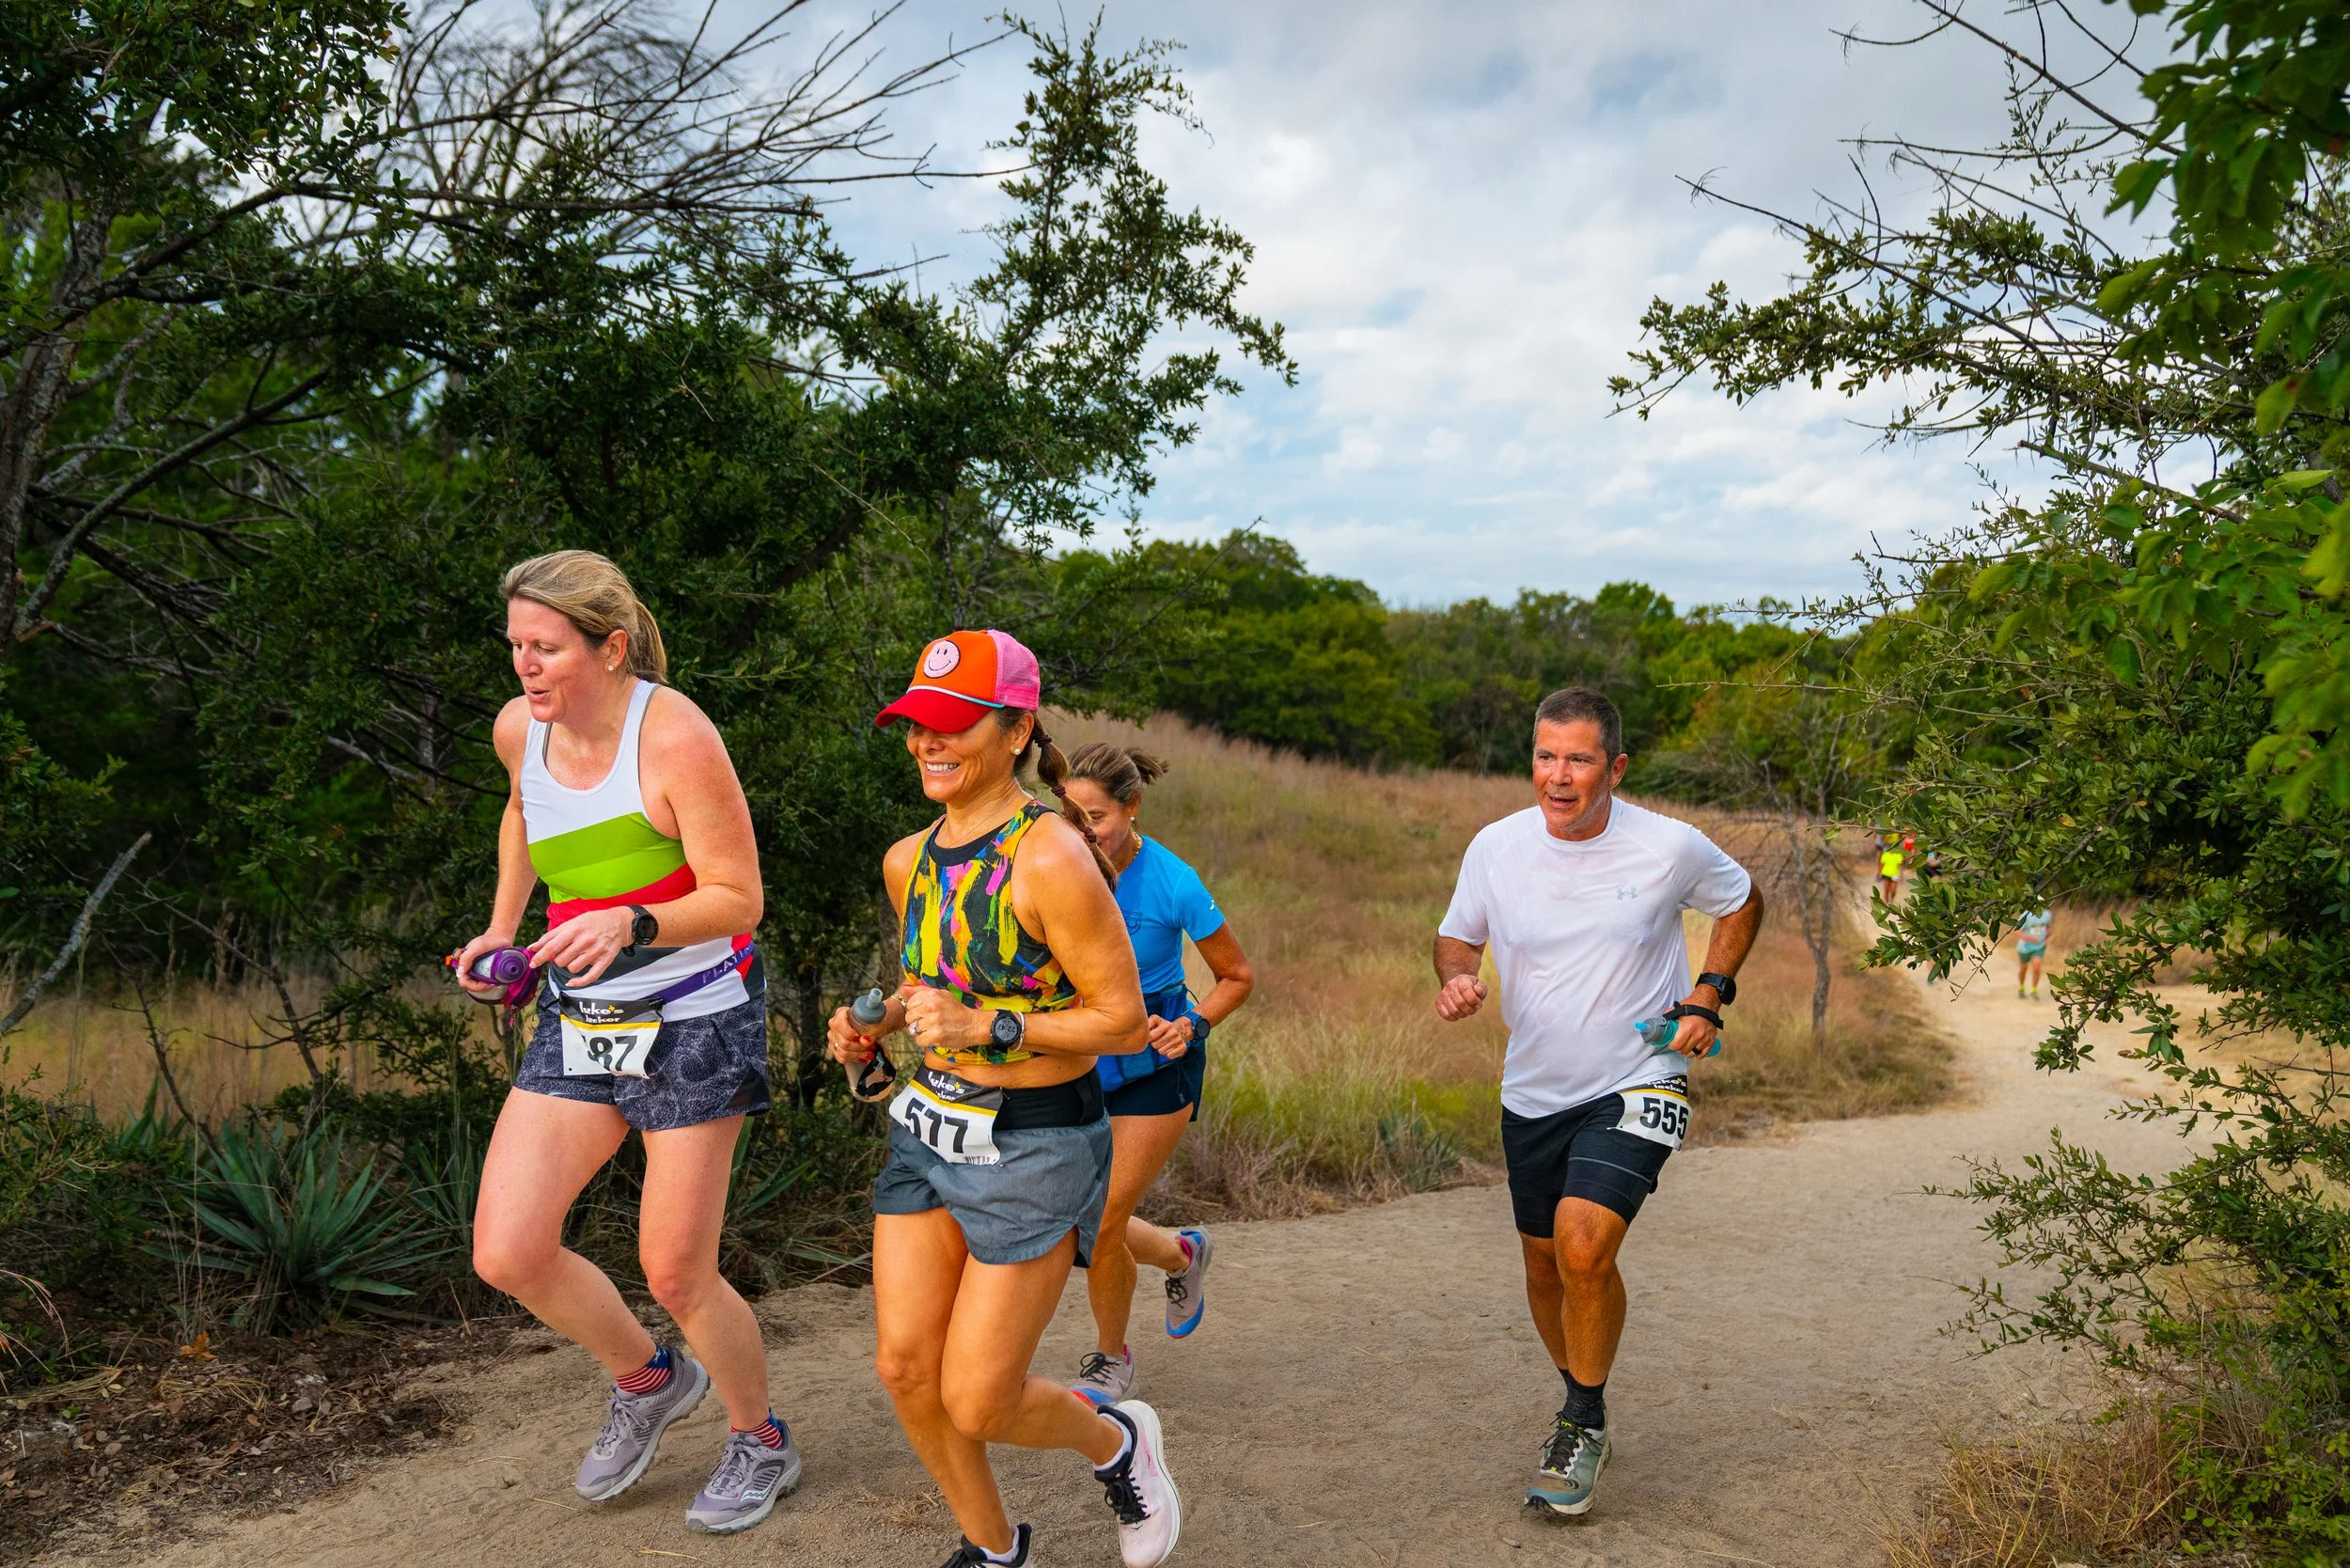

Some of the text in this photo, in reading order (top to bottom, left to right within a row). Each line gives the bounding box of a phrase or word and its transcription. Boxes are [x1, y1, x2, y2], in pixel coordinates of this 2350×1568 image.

[580, 1034, 638, 1072] 87
[927, 1071, 965, 1094] luke's
[903, 1096, 969, 1154] 577
[1639, 1097, 1689, 1140] 555
